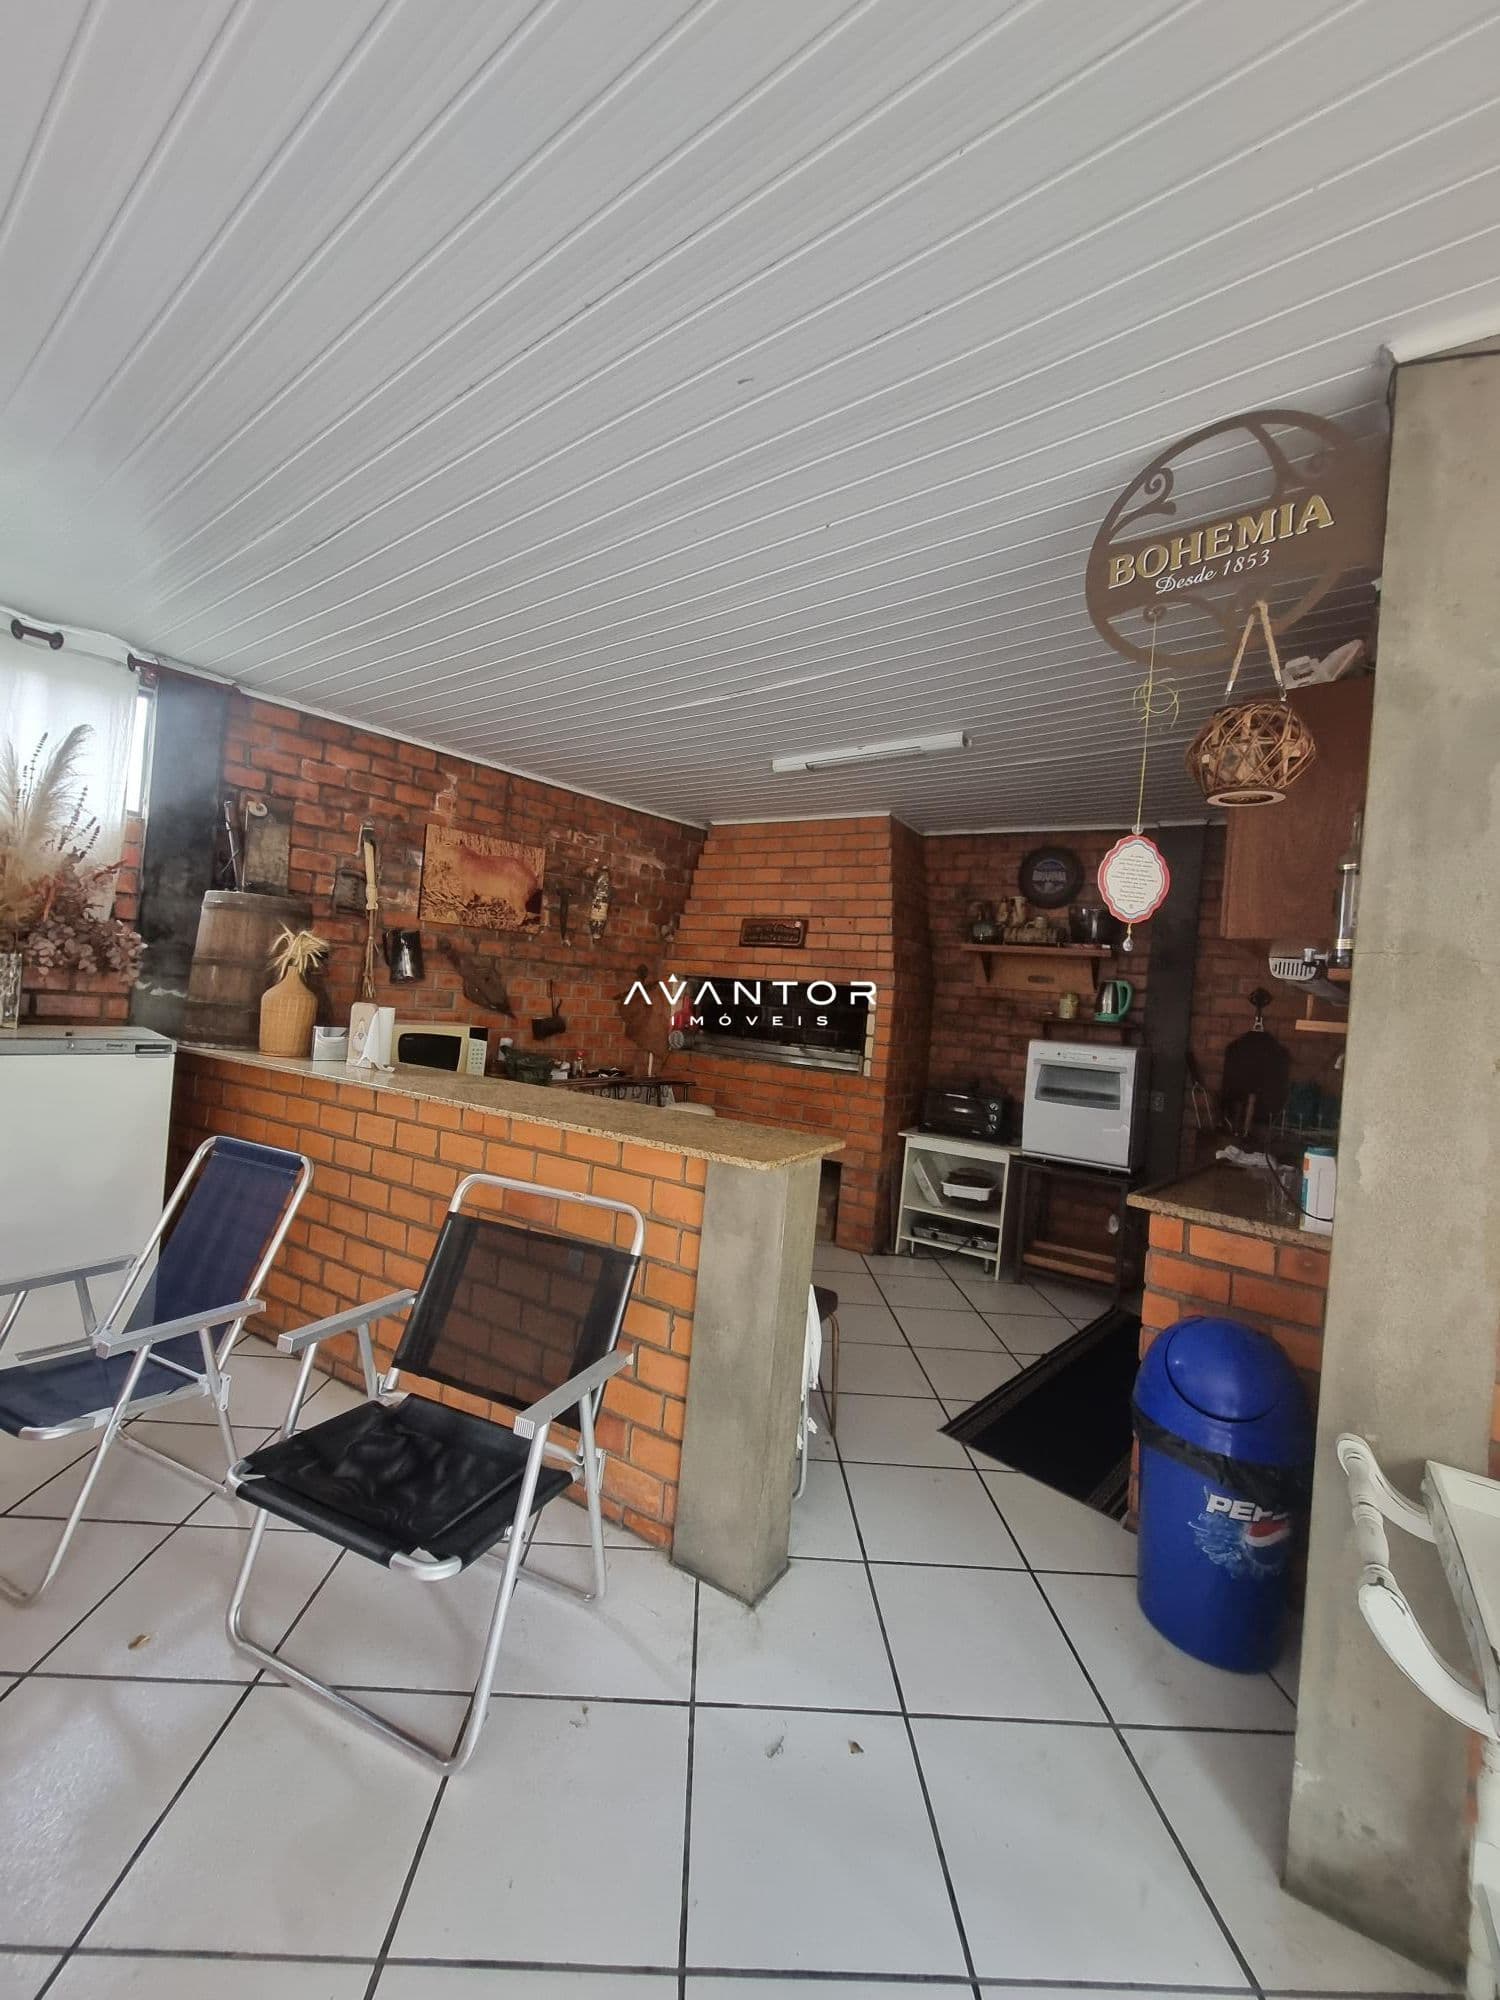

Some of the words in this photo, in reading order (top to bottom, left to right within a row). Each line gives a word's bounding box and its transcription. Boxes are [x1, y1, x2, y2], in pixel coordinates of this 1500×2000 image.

[1107, 494, 1335, 590] BOHEMIA
[1155, 565, 1217, 594] Desde
[1223, 549, 1270, 576] 1853
